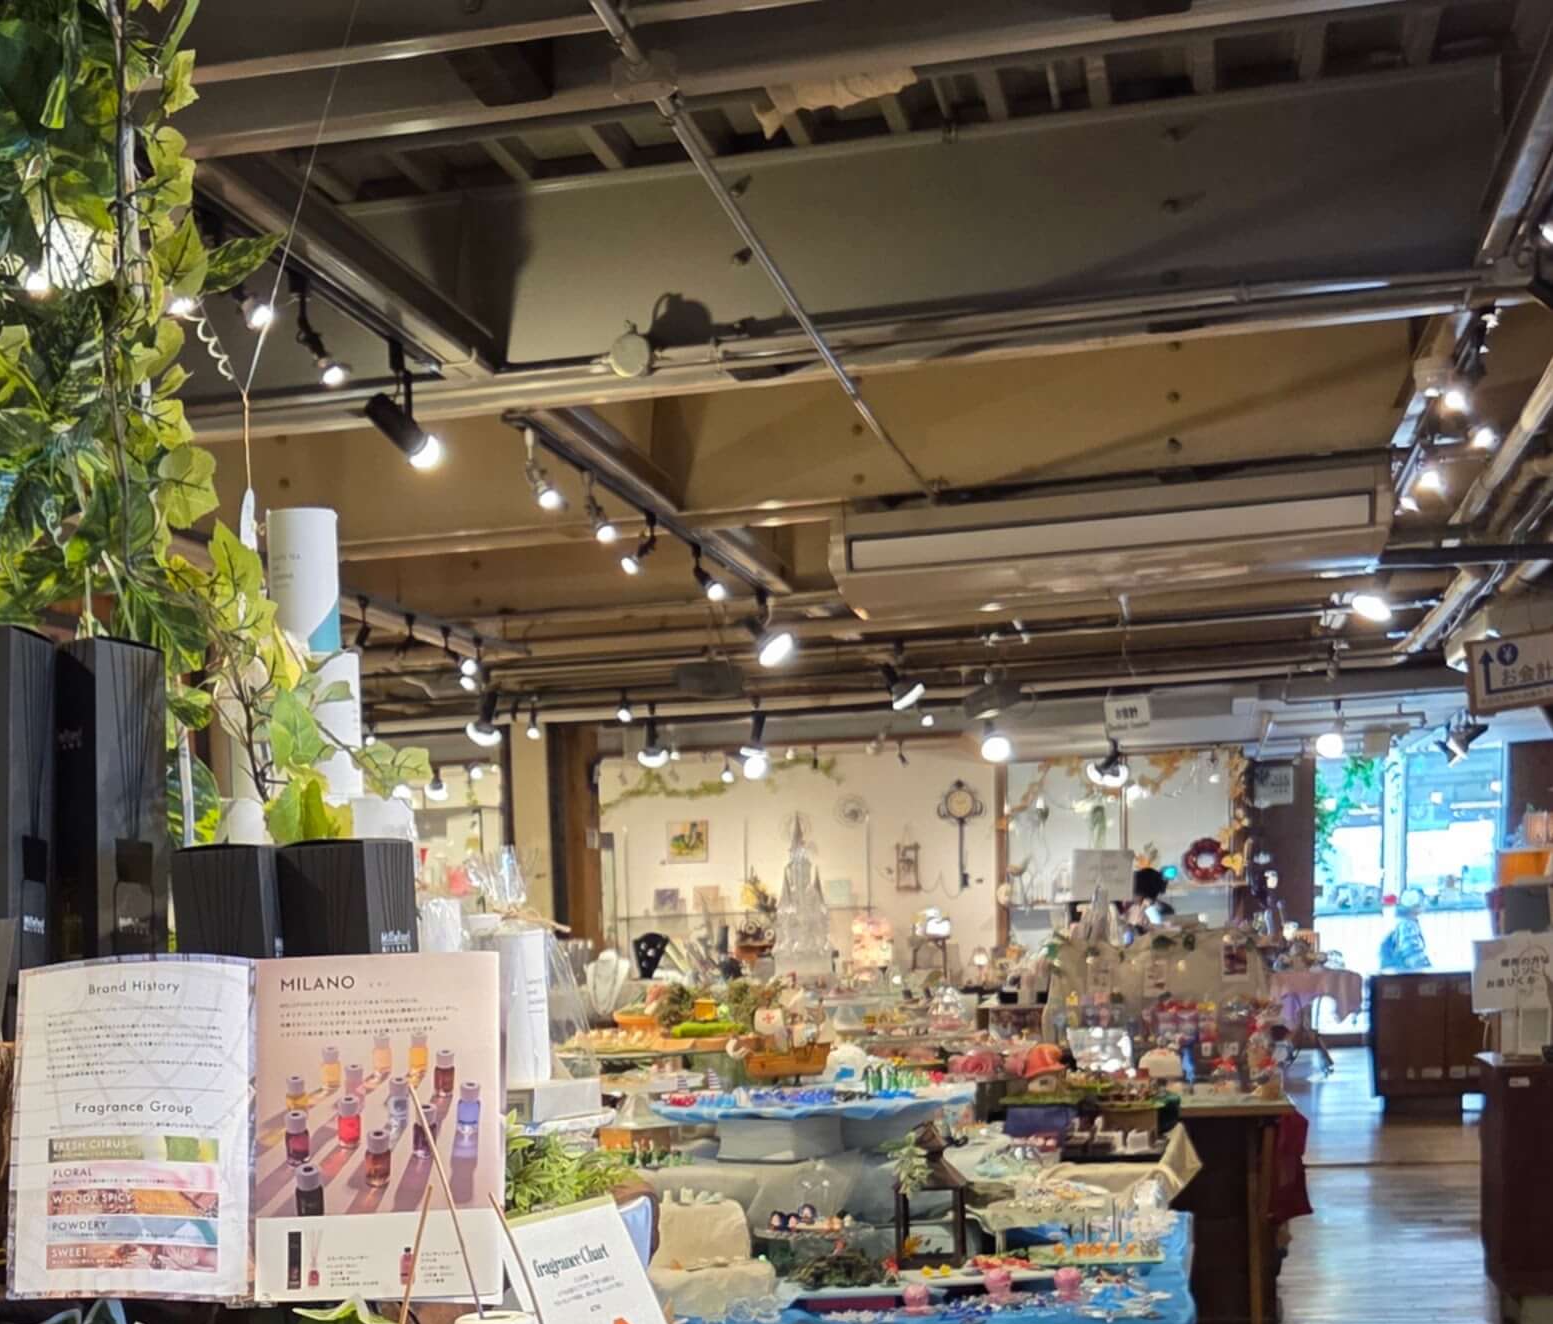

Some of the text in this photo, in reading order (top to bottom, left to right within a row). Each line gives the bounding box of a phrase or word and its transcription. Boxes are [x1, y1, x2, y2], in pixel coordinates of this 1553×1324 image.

[88, 981, 180, 997] Brand History
[280, 975, 355, 992] MILANO
[74, 1101, 193, 1116] Fragrance Group
[52, 1138, 127, 1150] FRESH CITRUS
[52, 1168, 92, 1178] FLORAL
[52, 1193, 134, 1204] WOODY SPICY
[52, 1220, 108, 1231] POWDERY
[52, 1247, 87, 1258] SWEET
[579, 1243, 610, 1265] Chart
